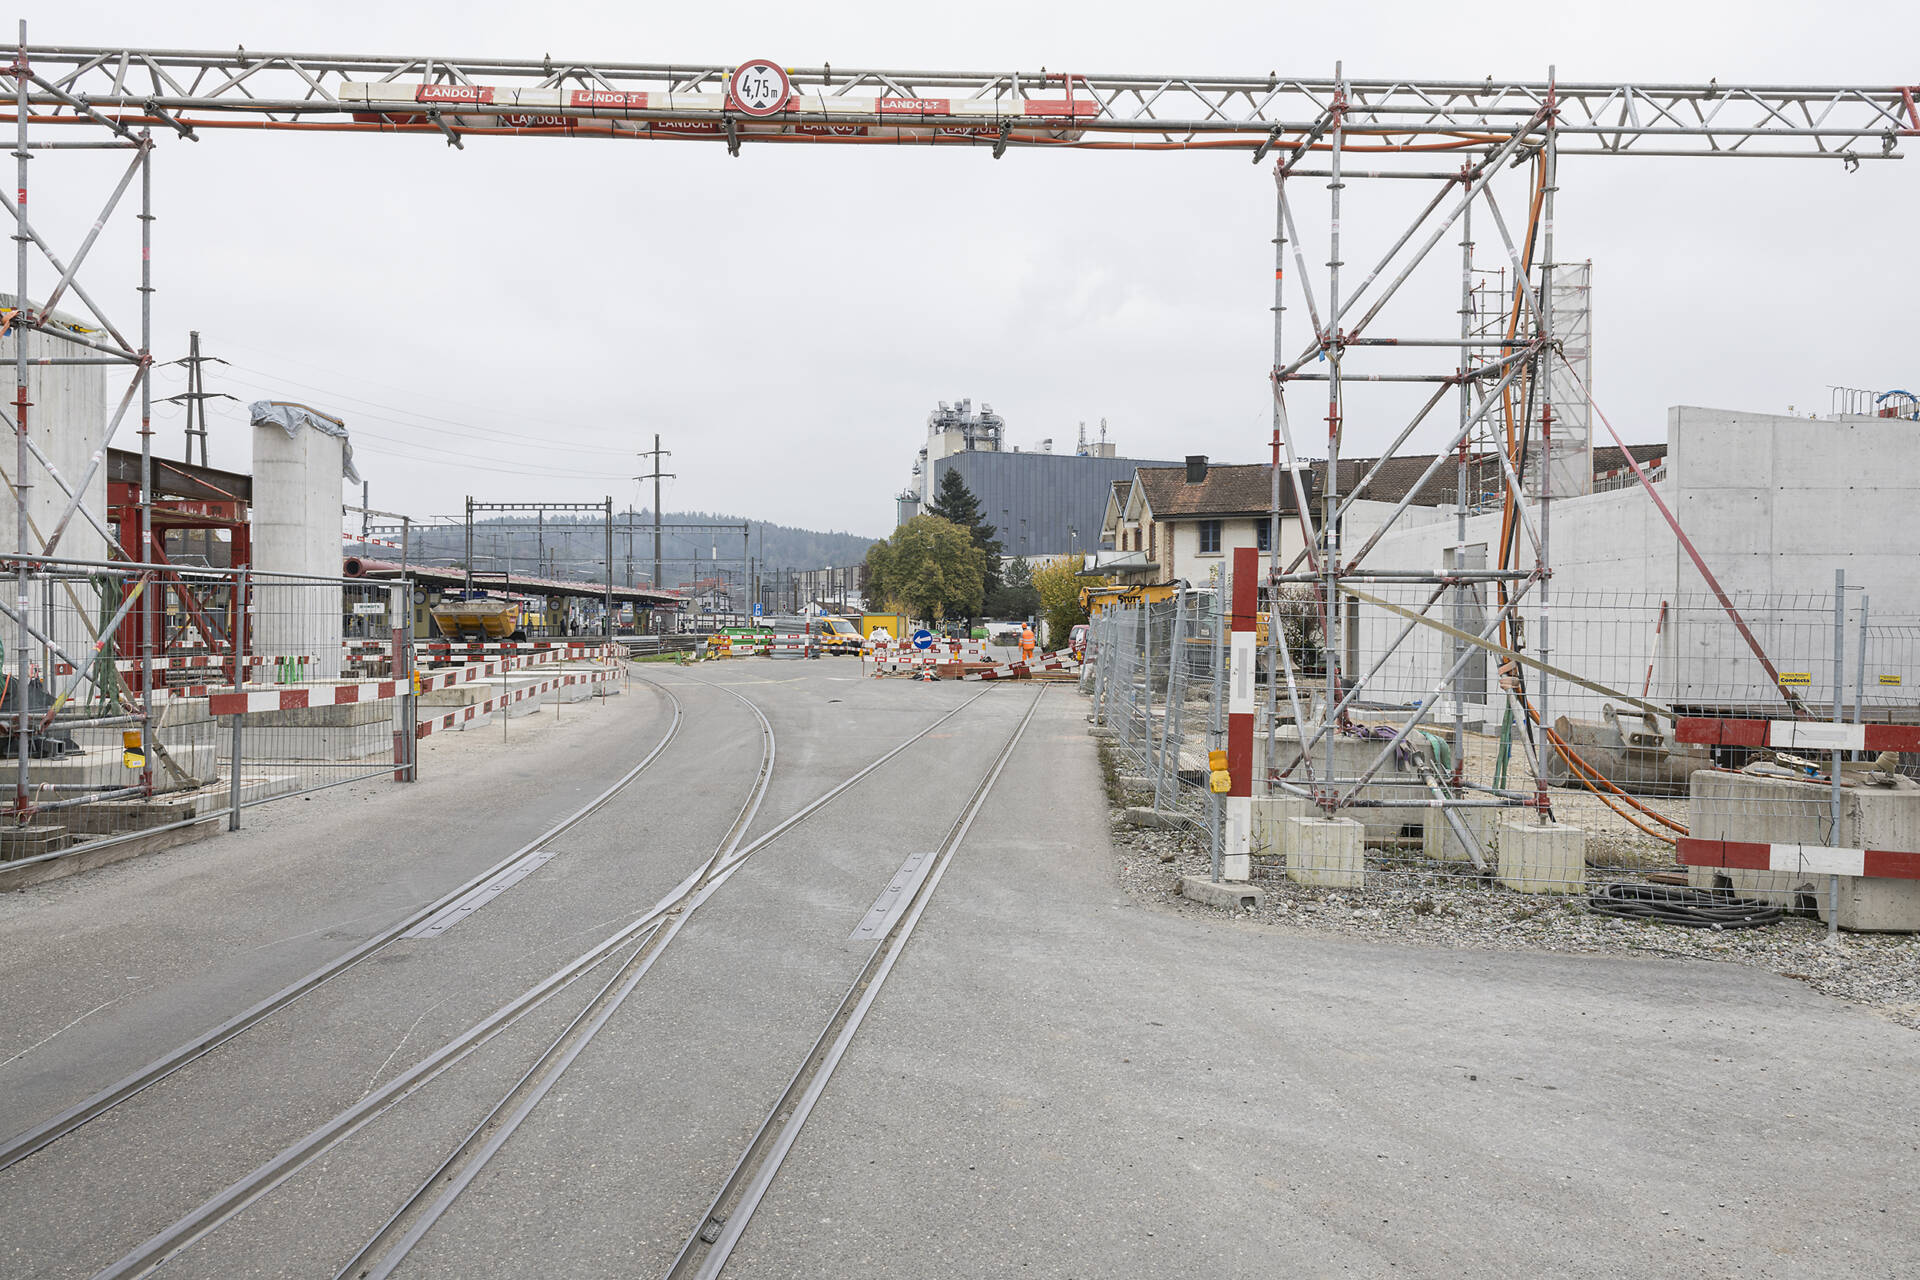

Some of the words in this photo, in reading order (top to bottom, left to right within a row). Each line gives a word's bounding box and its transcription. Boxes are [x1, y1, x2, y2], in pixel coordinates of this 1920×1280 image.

[742, 75, 769, 99] 4,75
[771, 89, 778, 98] m
[424, 88, 485, 98] LANDOLT
[880, 100, 940, 109] LANDOLT
